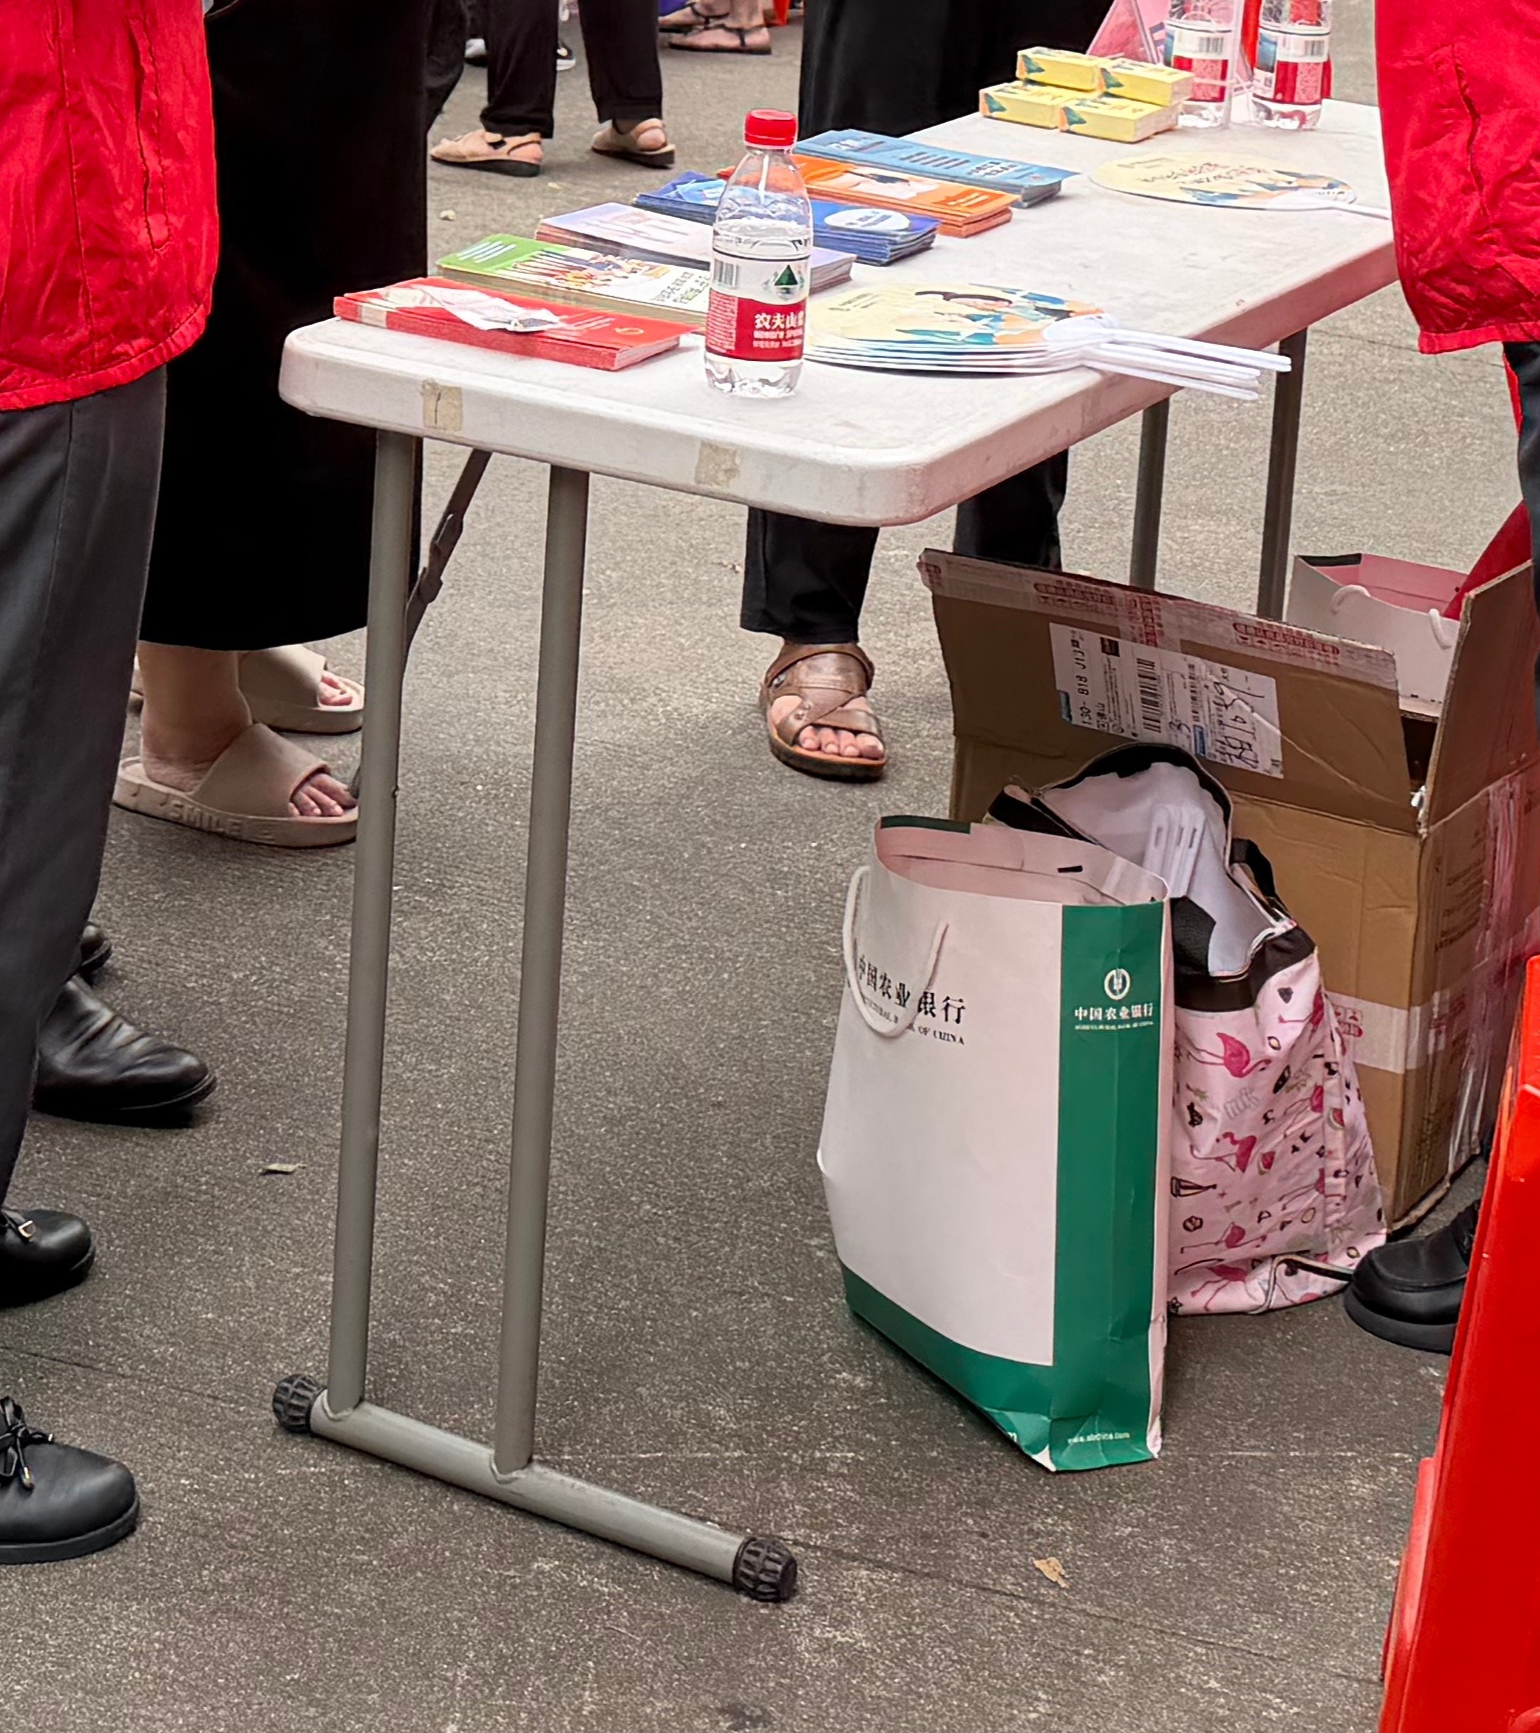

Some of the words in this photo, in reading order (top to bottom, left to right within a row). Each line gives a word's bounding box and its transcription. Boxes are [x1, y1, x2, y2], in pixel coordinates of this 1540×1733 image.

[1074, 1002, 1154, 1021] 中国农业银行
